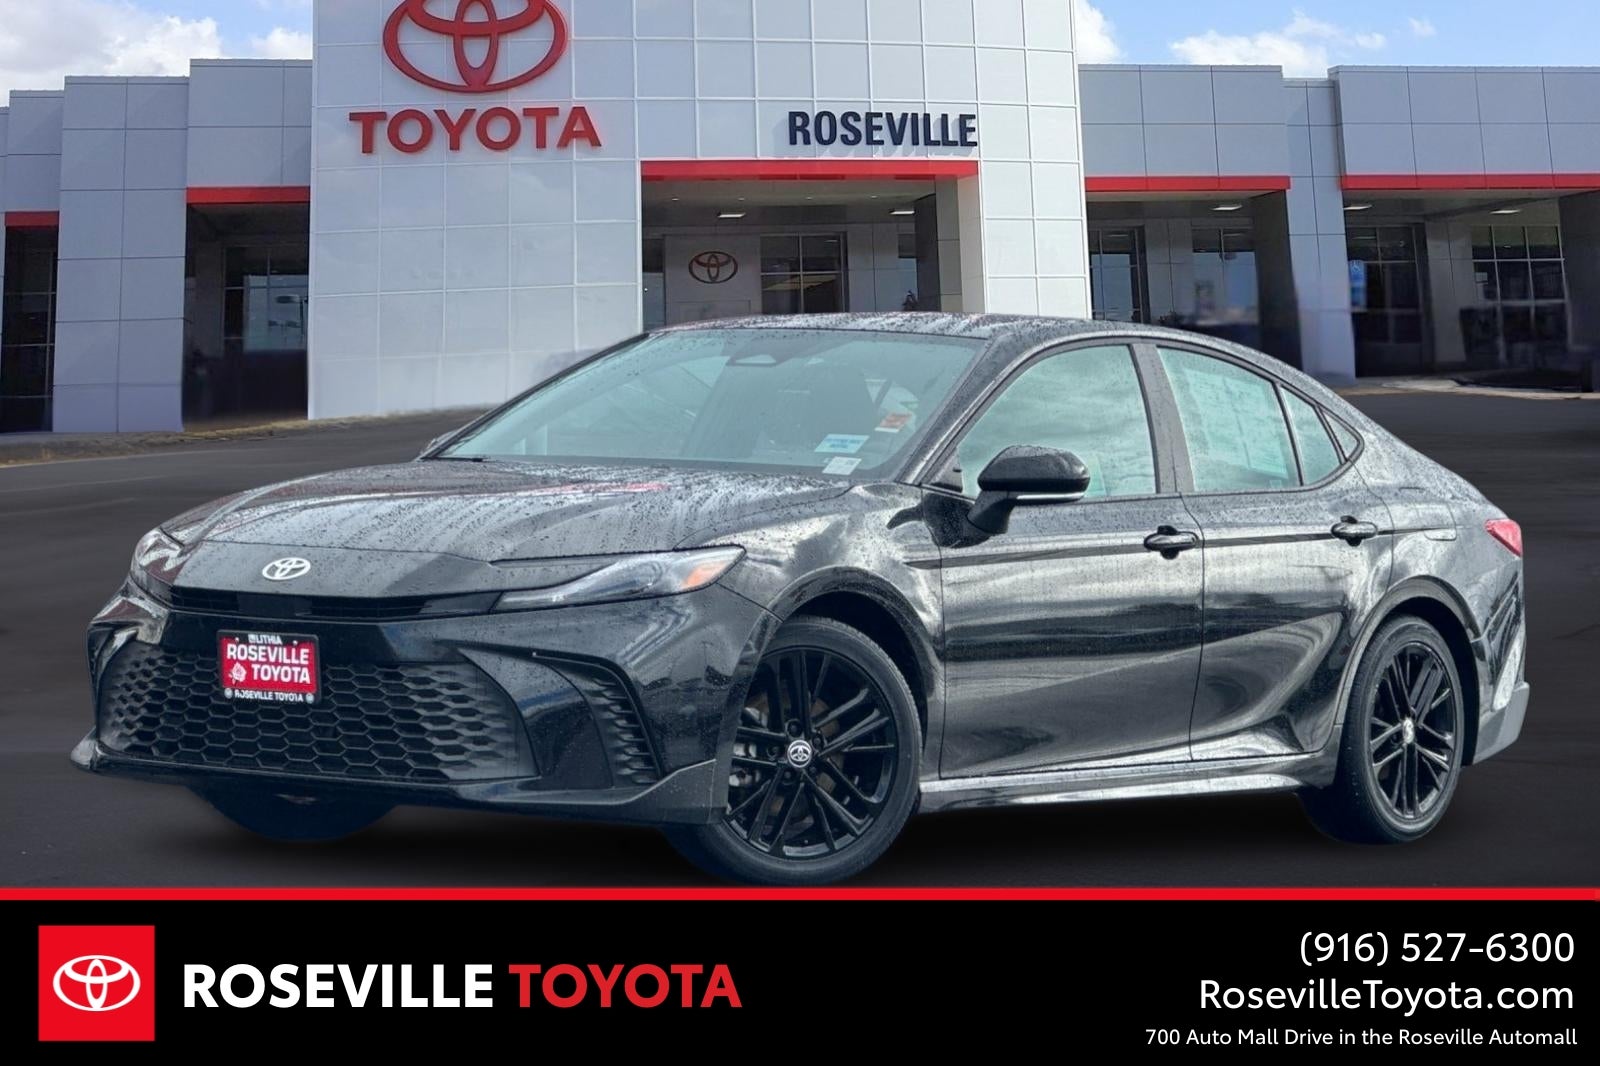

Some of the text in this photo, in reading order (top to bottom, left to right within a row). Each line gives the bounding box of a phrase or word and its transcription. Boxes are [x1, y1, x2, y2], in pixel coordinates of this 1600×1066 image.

[349, 106, 602, 154] TOYOTA
[788, 111, 978, 147] ROSEVILLE
[256, 634, 282, 645] LITHIA
[227, 643, 309, 665] ROSEVILLE
[251, 663, 311, 685] TOYOTA
